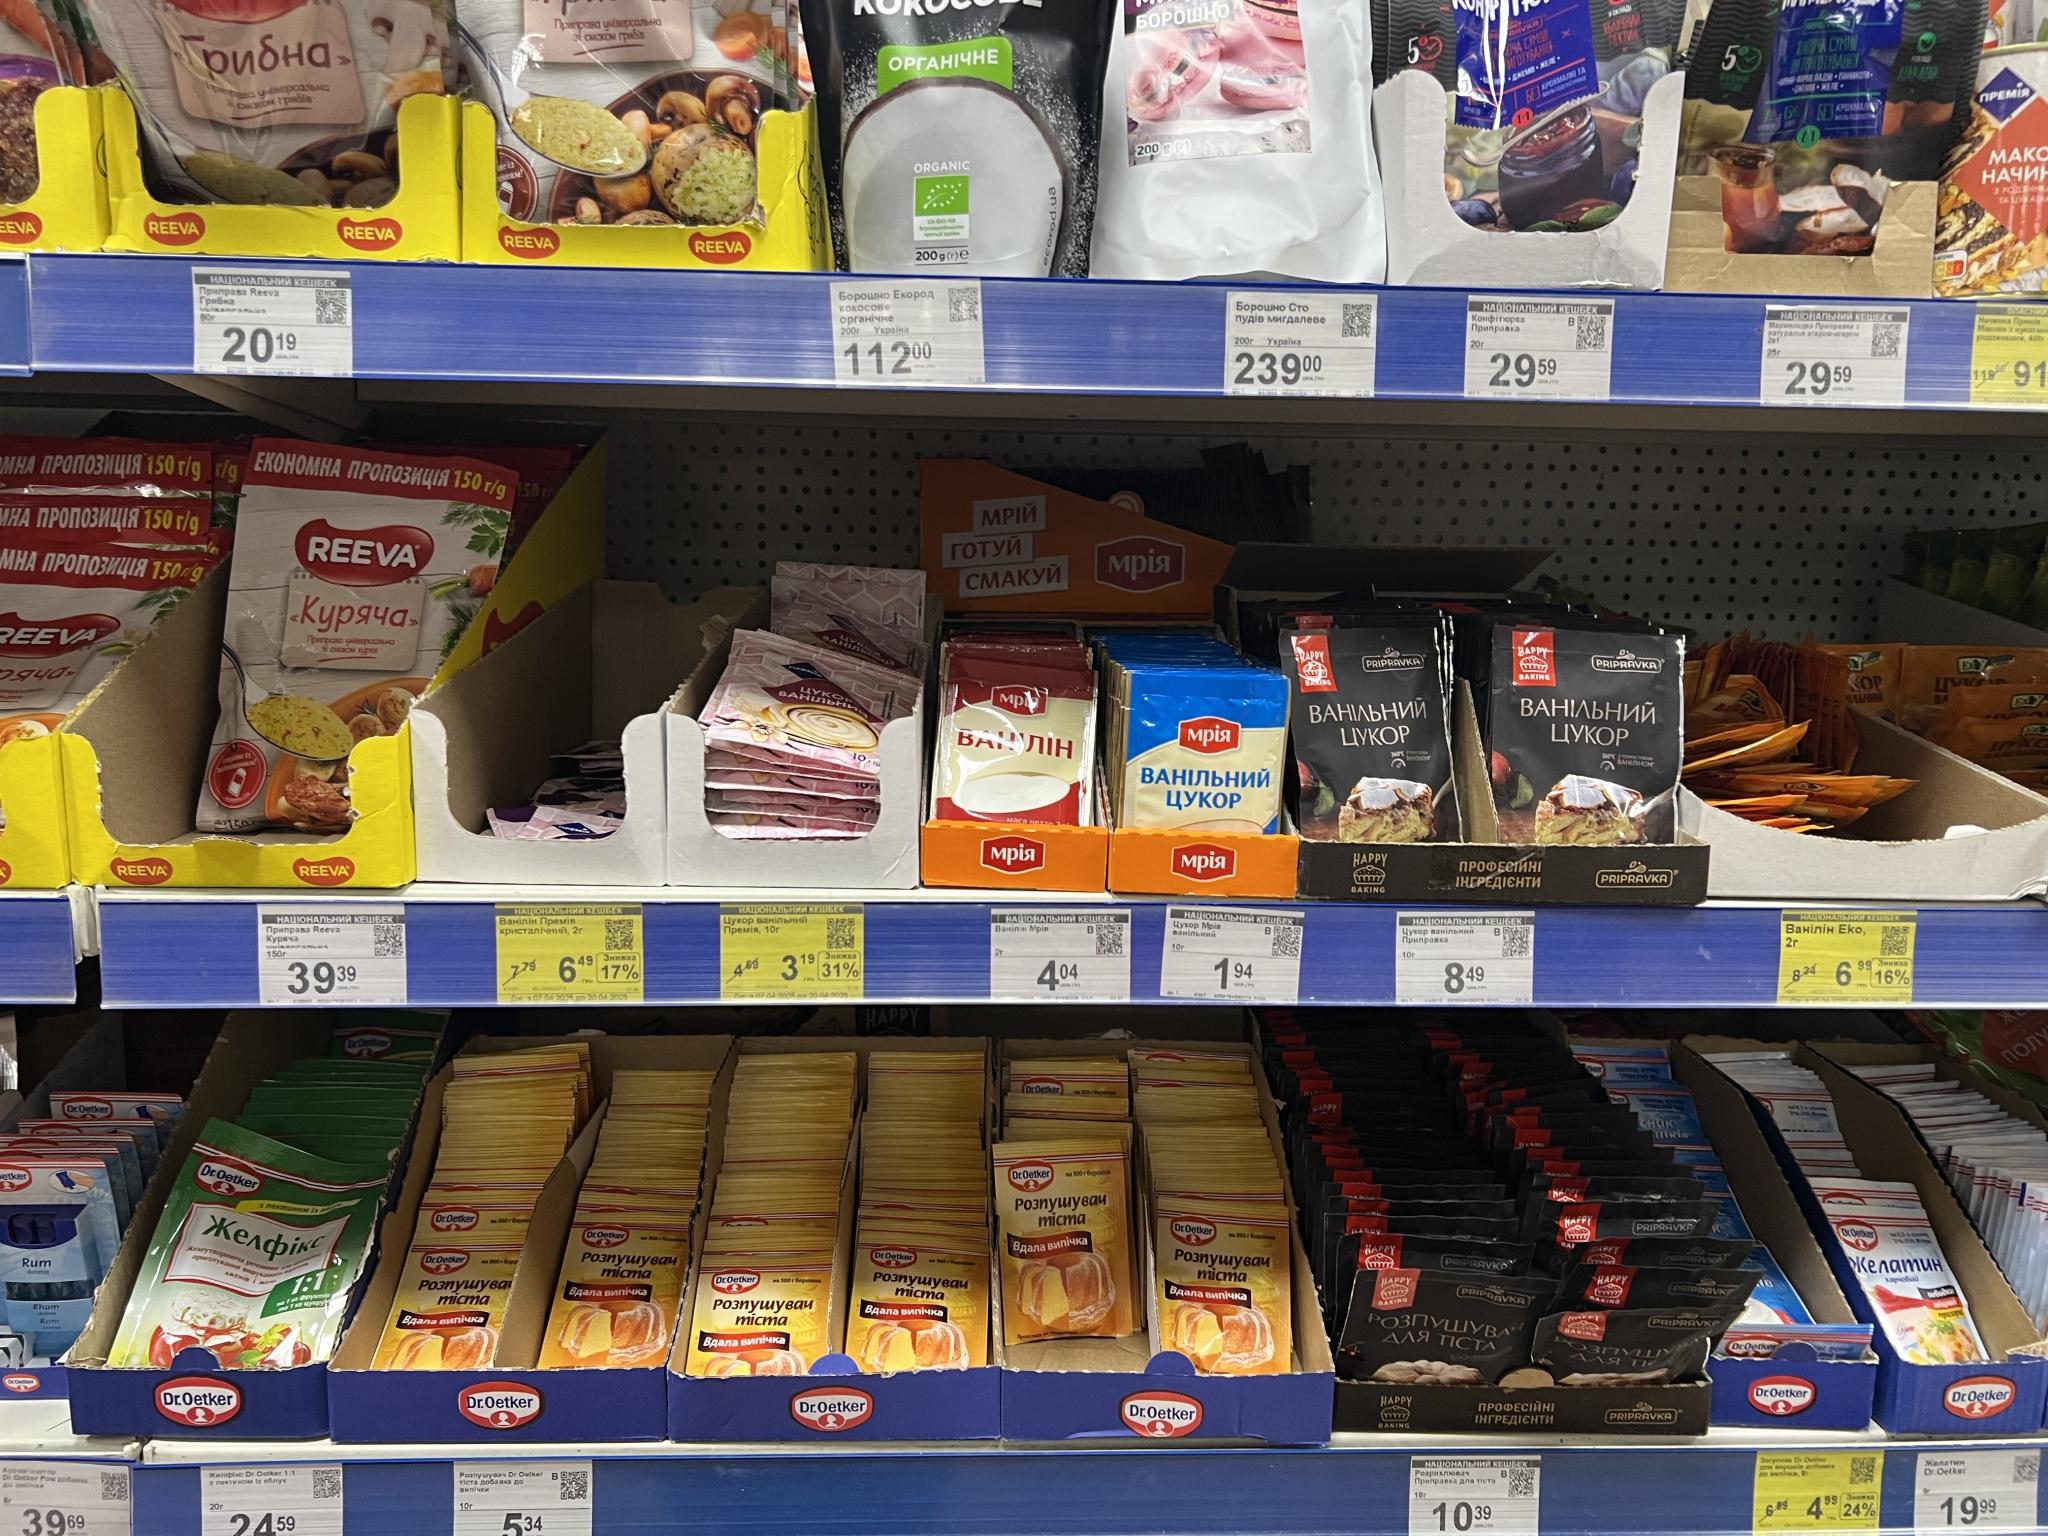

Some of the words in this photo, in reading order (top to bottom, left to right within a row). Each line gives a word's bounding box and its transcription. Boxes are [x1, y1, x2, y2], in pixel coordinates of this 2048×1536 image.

[1136, 4, 1230, 29] БОРОШНО
[888, 49, 999, 71] ОРГАНІЧНЕ
[914, 160, 970, 173] ORGANIC
[149, 220, 200, 236] REEVA
[343, 226, 396, 241] REEVA
[504, 234, 555, 250] REEVA
[694, 239, 746, 255] REEVA
[294, 278, 337, 288] КЕШБЕК
[838, 291, 890, 302] Борошно
[893, 289, 935, 301] Екород
[1236, 301, 1287, 313] Борошно
[1289, 302, 1309, 313] Сто
[1483, 303, 1557, 314] НАЦІОНАЛЬНИЙ
[1559, 305, 1598, 314] КЕШБЕК
[839, 314, 894, 326] органічне
[1235, 314, 1265, 325] пудів
[1267, 315, 1326, 325] мигдалеве
[222, 326, 274, 363] 20
[276, 333, 297, 351] 19
[844, 341, 912, 376] 112
[912, 342, 932, 360] 00
[1234, 352, 1302, 386] 239
[1303, 355, 1322, 373] 00
[1489, 353, 1536, 387] 29
[1538, 359, 1557, 376] 59
[1785, 361, 1831, 396] 29
[1833, 366, 1852, 383] 59
[40, 454, 143, 479] ПРОПОЗИЦІЯ
[147, 454, 176, 476] 150
[254, 451, 341, 478] ЕКОНОМНА
[347, 460, 451, 491] ПРОПОЗИЦІЯ
[454, 470, 483, 491] 150
[36, 507, 140, 532] ПРОПОЗИЦІЯ
[144, 509, 173, 529] 150
[981, 502, 1038, 528] МРІЙ
[307, 536, 417, 569] REEVA
[951, 535, 1022, 561] ГОТУЙ
[42, 552, 150, 580] ПРОПОЗИЦІЯ
[966, 562, 1062, 594] СМАКУЙ
[1365, 657, 1421, 670] PRIPRAVKA
[1596, 659, 1659, 672] PRIPRAVKA
[1518, 673, 1551, 682] BAKING
[1308, 697, 1427, 725] ВАНІЛЬНИЙ
[1519, 698, 1656, 726] ВАНІЛЬНИЙ
[1340, 725, 1411, 749] ЦУКОР
[1550, 723, 1630, 748] ЦУКОР
[957, 729, 1074, 760] ВАНІЛІН
[1140, 766, 1271, 791] ВАНІЛЬНИЙ
[1165, 790, 1242, 812] ЦУКОР
[1353, 853, 1388, 867] HAPPY
[1458, 858, 1543, 873] ПРОФЕСІЙНІ
[116, 863, 168, 878] REEVA
[299, 863, 351, 878] REEVA
[1455, 875, 1542, 890] ІНГРЕДІЄНТИ
[1600, 872, 1669, 885] PRIPRAVKA
[1351, 885, 1386, 894] BAKING
[515, 908, 585, 917] НАЦІОНАЛЬНИЙ
[738, 906, 808, 915] НАЦІОНАЛЬНИЙ
[809, 905, 845, 914] КЕШБЕК
[277, 914, 352, 924] НАЦІОНАЛЬНИЙ
[354, 916, 394, 924] КЕШБЕК
[500, 917, 537, 926] Ванілін
[540, 917, 576, 926] Премія
[723, 916, 754, 926] Цукор
[756, 916, 808, 925] ванільний
[1005, 915, 1076, 924] НАЦІОНАЛЬНИЙ
[1078, 915, 1116, 923] КЕШБЕК
[1173, 921, 1200, 930] Цукор
[1201, 922, 1221, 930] Мрія
[1184, 911, 1255, 922] НАЦІОНАЛЬНИЙ
[1257, 917, 1295, 926] КЕШБЕК
[1413, 918, 1484, 926] НАЦІОНАЛЬНИЙ
[1485, 918, 1523, 926] КЕШБЕК
[266, 926, 311, 935] Приправа
[313, 926, 341, 934] Reeva
[723, 926, 761, 935] Премія,
[764, 926, 780, 934] 10г
[995, 925, 1027, 933] Ванілін
[1173, 930, 1217, 938] ванільний
[1402, 928, 1429, 936] Цукор
[1431, 927, 1475, 935] ванільний
[1786, 924, 1834, 934] Ванілін
[266, 935, 299, 943] Куряча
[1402, 936, 1449, 945] Приправка
[1786, 937, 1798, 948] 2г
[266, 951, 287, 959] 150г
[603, 954, 637, 963] Знижка
[559, 956, 577, 983] 6
[577, 955, 593, 967] 49
[601, 964, 639, 980] 17%
[781, 954, 798, 981] 3
[800, 953, 815, 965] 19
[822, 961, 860, 979] 31%
[1214, 957, 1230, 990] 1
[1234, 963, 1253, 980] 94
[1836, 961, 1852, 987] 6
[287, 962, 335, 994] 39
[337, 966, 357, 982] 39
[1037, 959, 1060, 992] 4
[1060, 963, 1079, 980] 04
[1444, 962, 1465, 994] 8
[1466, 966, 1485, 983] 49
[1875, 969, 1910, 985] 16%
[1015, 1194, 1107, 1212] Розпушувач
[202, 1213, 326, 1261] Желфікс
[1365, 1244, 1397, 1256] HAPPY
[23, 1257, 51, 1269] Rum
[581, 1252, 677, 1267] Розпушувач
[1174, 1249, 1271, 1268] Розпушувач
[873, 1271, 969, 1290] Розпушувач
[1381, 1276, 1412, 1288] HAPPY
[1597, 1274, 1629, 1286] HAPPY
[568, 1286, 603, 1298] Вдала
[603, 1287, 648, 1298] випічка
[1205, 1289, 1248, 1301] випічка
[712, 1299, 813, 1314] Розпушувач
[1378, 1297, 1409, 1306] BAKING
[864, 1304, 899, 1317] Вдала
[900, 1307, 945, 1317] випічка
[401, 1314, 438, 1327] Вдала
[439, 1313, 485, 1326] випічка
[703, 1336, 739, 1348] Вдала
[740, 1335, 786, 1346] випічка
[1382, 1332, 1431, 1345] ДЛЯ
[1381, 1395, 1413, 1408] HAPPY
[1478, 1401, 1556, 1414] ПРОФЕСІЙНІ
[1475, 1414, 1555, 1425] ІНГРЕДІЄНТИ
[1609, 1410, 1674, 1422] PRIPRAVKA
[1378, 1421, 1410, 1429] BAKING
[1425, 1460, 1491, 1468] НАЦІОНАЛЬНИЙ
[1806, 1497, 1823, 1520] 4
[1843, 1503, 1876, 1517] 24%
[1941, 1496, 1978, 1526] 19
[1980, 1499, 1997, 1514] 99
[22, 1509, 66, 1536] 39
[67, 1515, 85, 1529] 69
[276, 1516, 295, 1532] 59
[525, 1516, 543, 1532] 34
[1433, 1502, 1473, 1532] 10
[1474, 1506, 1492, 1520] 39
